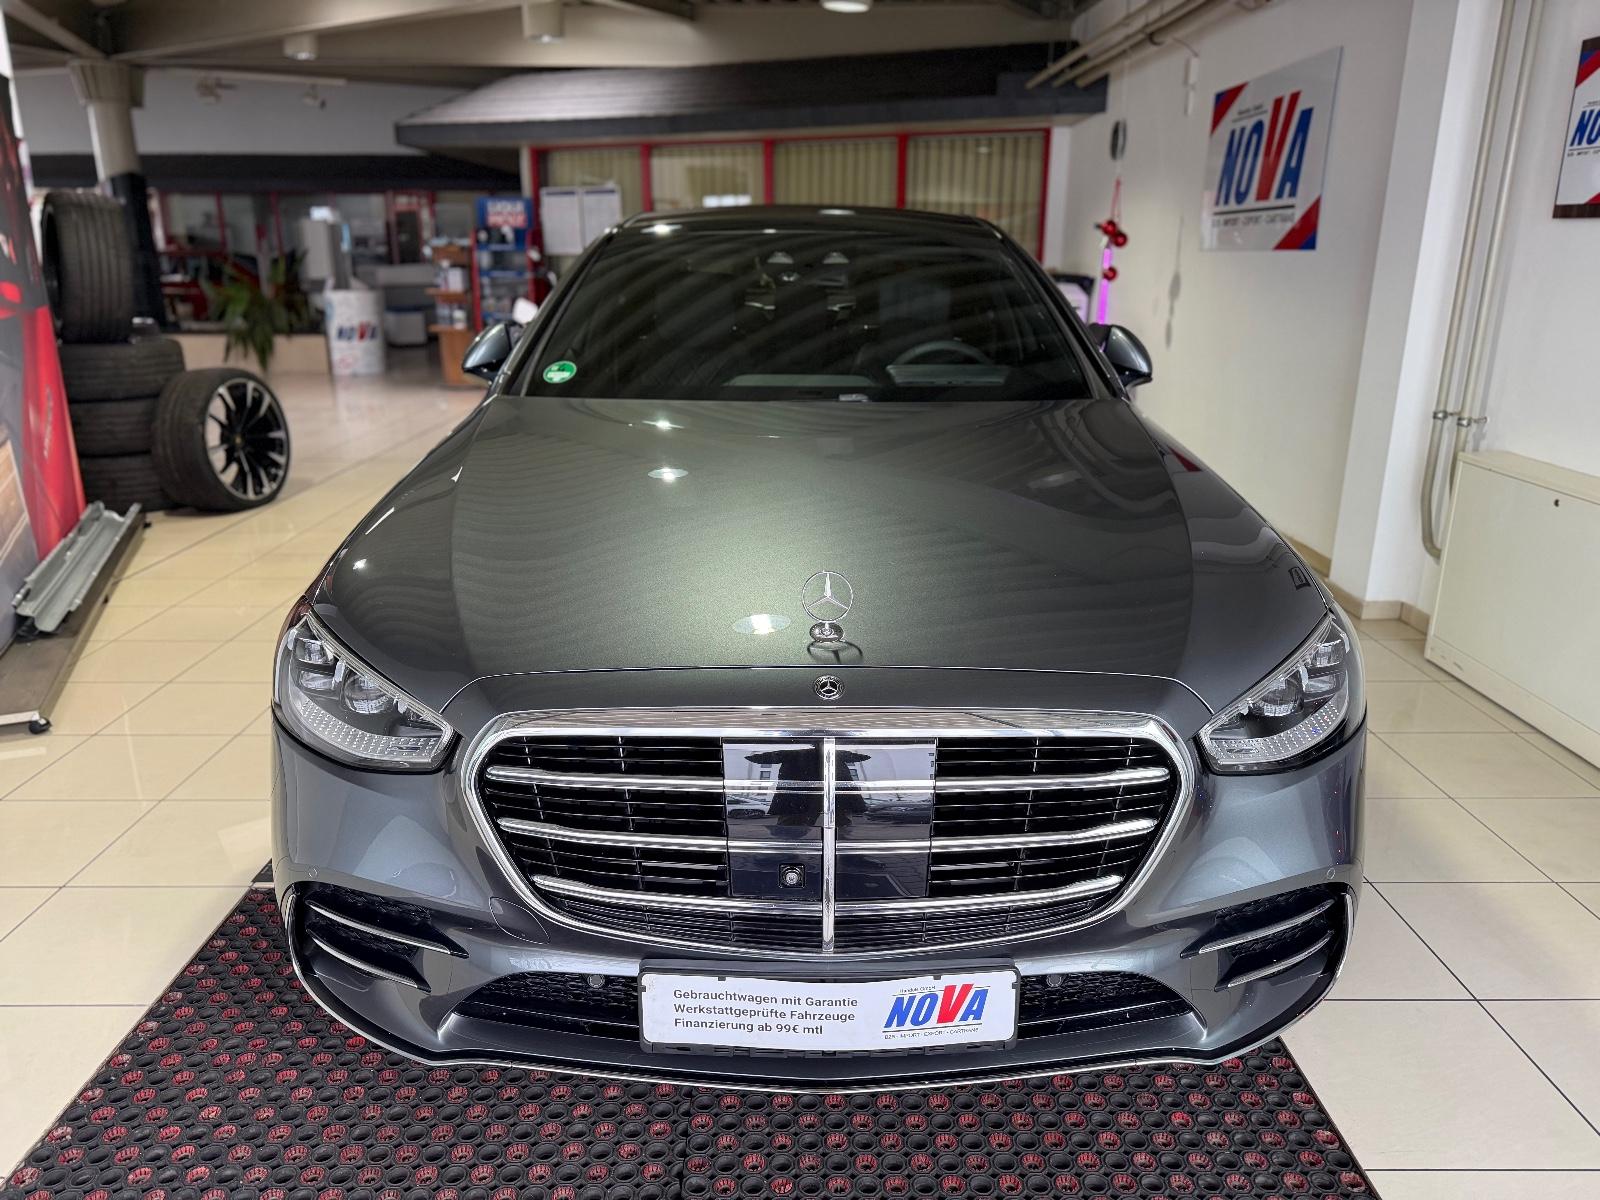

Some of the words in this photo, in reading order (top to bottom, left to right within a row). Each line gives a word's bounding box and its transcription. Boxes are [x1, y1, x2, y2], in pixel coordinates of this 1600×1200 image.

[1214, 90, 1314, 207] NOVA
[673, 989, 778, 1005] Gebrauchtwagen
[781, 996, 802, 1006] mit
[805, 996, 858, 1007] Garantie
[884, 983, 989, 1029] NOVA
[673, 1003, 787, 1019] Werkstattgeprüfte
[790, 1010, 856, 1023] Fahrzeuge
[674, 1018, 754, 1033] Finanzierung
[757, 1022, 772, 1032] ab
[775, 1023, 799, 1034] 99€
[802, 1024, 823, 1035] mtl
